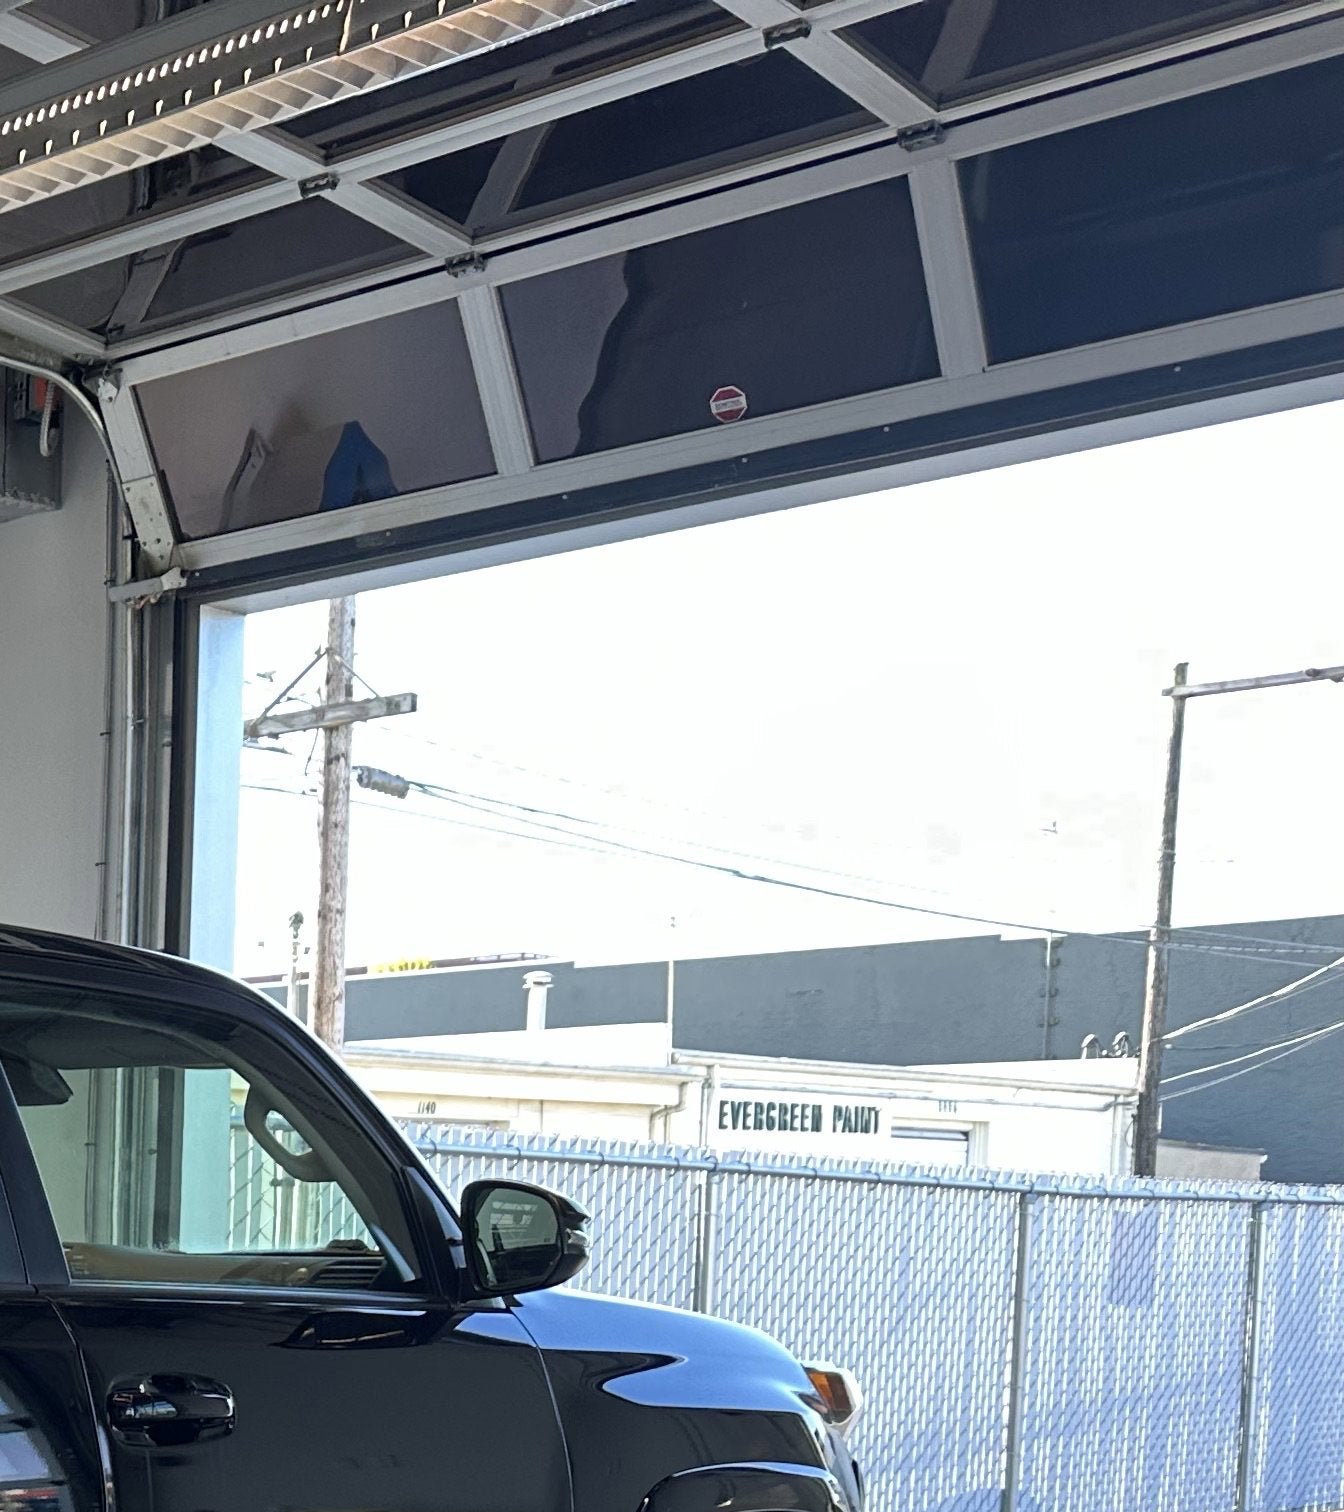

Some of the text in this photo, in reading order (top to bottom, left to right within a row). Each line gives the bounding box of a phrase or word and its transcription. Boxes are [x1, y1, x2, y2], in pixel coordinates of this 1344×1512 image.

[417, 1100, 436, 1115] 1140
[718, 1099, 880, 1134] EVERGREEN PAINT
